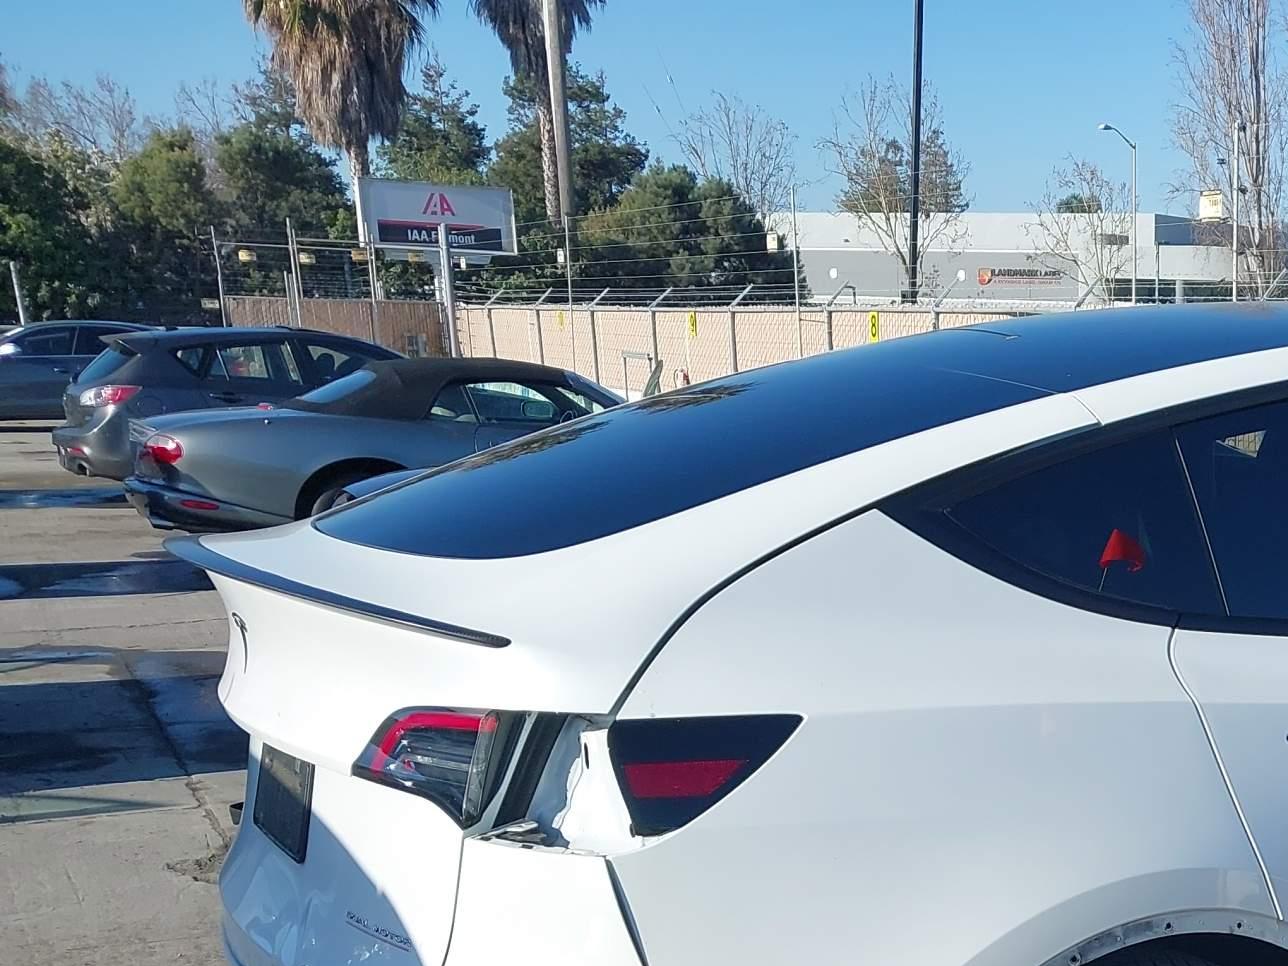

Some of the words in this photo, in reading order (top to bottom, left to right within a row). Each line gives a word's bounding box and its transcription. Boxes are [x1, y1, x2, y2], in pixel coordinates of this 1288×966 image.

[407, 229, 429, 241] IAA
[431, 230, 475, 244] Fmont
[992, 268, 1038, 277] LANDMARK
[871, 314, 877, 337] 8
